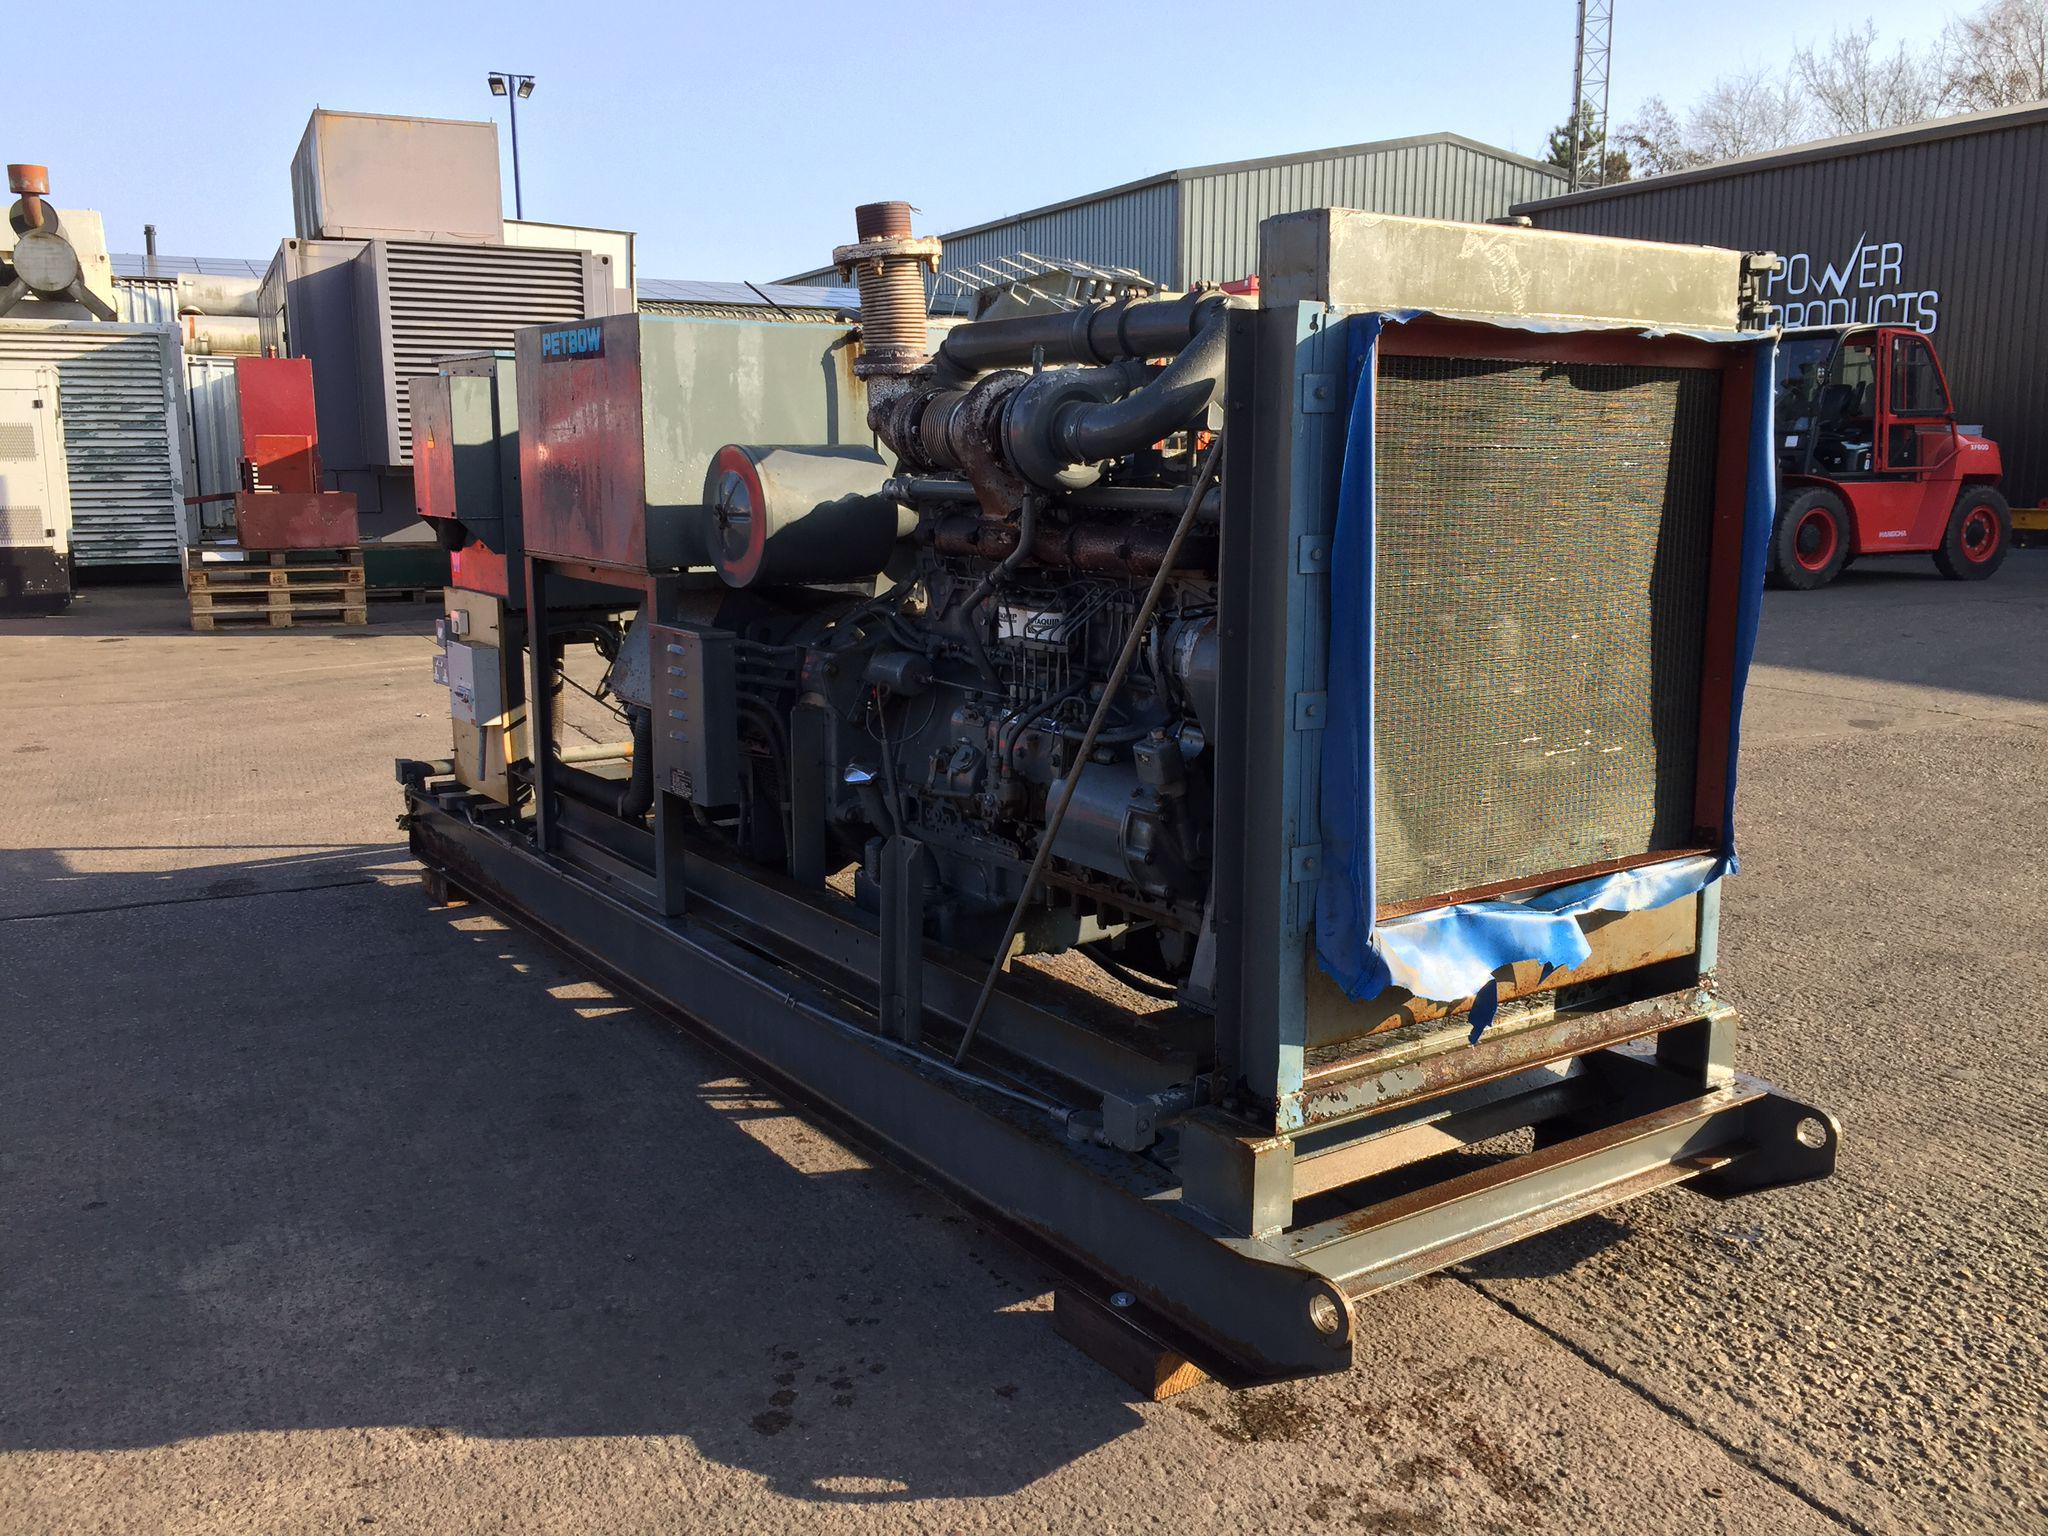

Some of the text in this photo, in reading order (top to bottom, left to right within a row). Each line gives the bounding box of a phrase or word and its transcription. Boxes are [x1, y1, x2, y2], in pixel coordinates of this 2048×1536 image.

[1767, 231, 1904, 297] POWER
[1764, 290, 1939, 334] PRODUCTS
[543, 327, 601, 356] PETBOW
